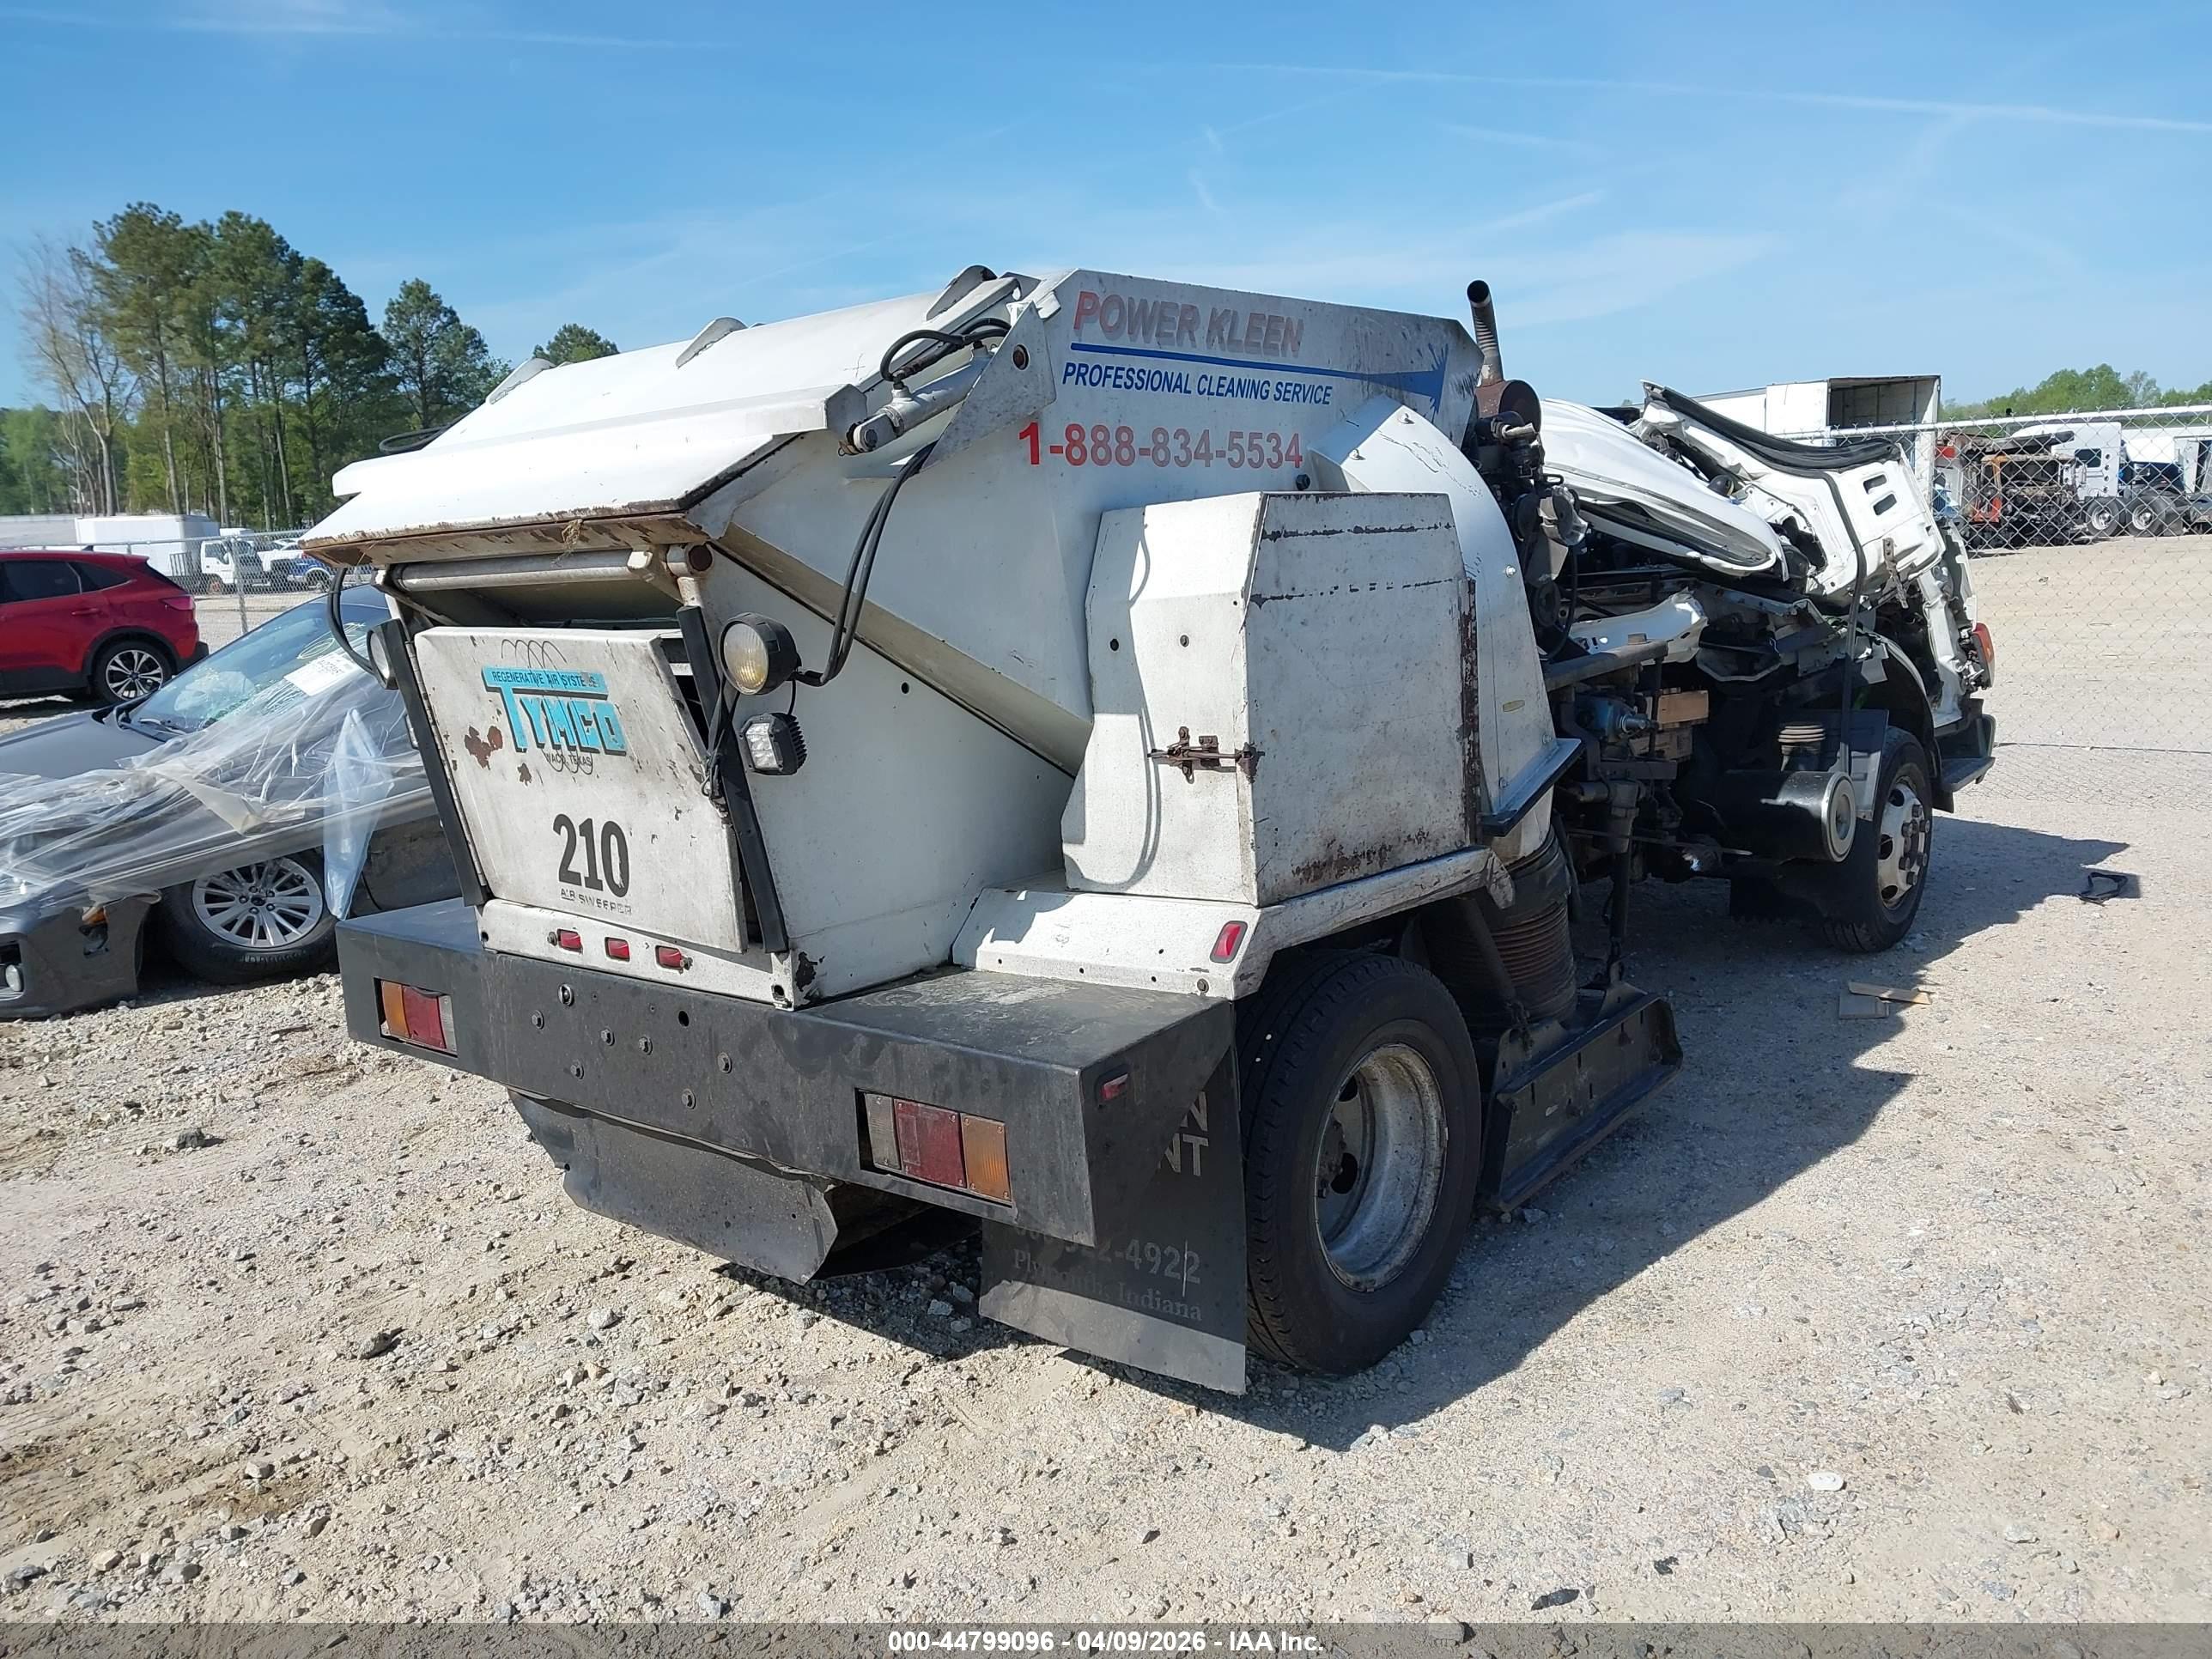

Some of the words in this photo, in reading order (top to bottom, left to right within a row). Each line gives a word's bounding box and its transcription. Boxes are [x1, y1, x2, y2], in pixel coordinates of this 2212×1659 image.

[1073, 291, 1200, 348] POWER
[1207, 307, 1305, 358] KLEEN
[1062, 362, 1193, 395] PROFESSIONAL
[1197, 374, 1270, 401] CLEANING
[1273, 380, 1333, 405] SERVICE
[1019, 422, 1304, 469] 1-888-834-5534
[491, 672, 544, 685] REGENERATIVE
[547, 673, 560, 686] AIR
[562, 674, 599, 687] SYSTES
[482, 665, 626, 756] TYMCO
[552, 813, 630, 898] 210
